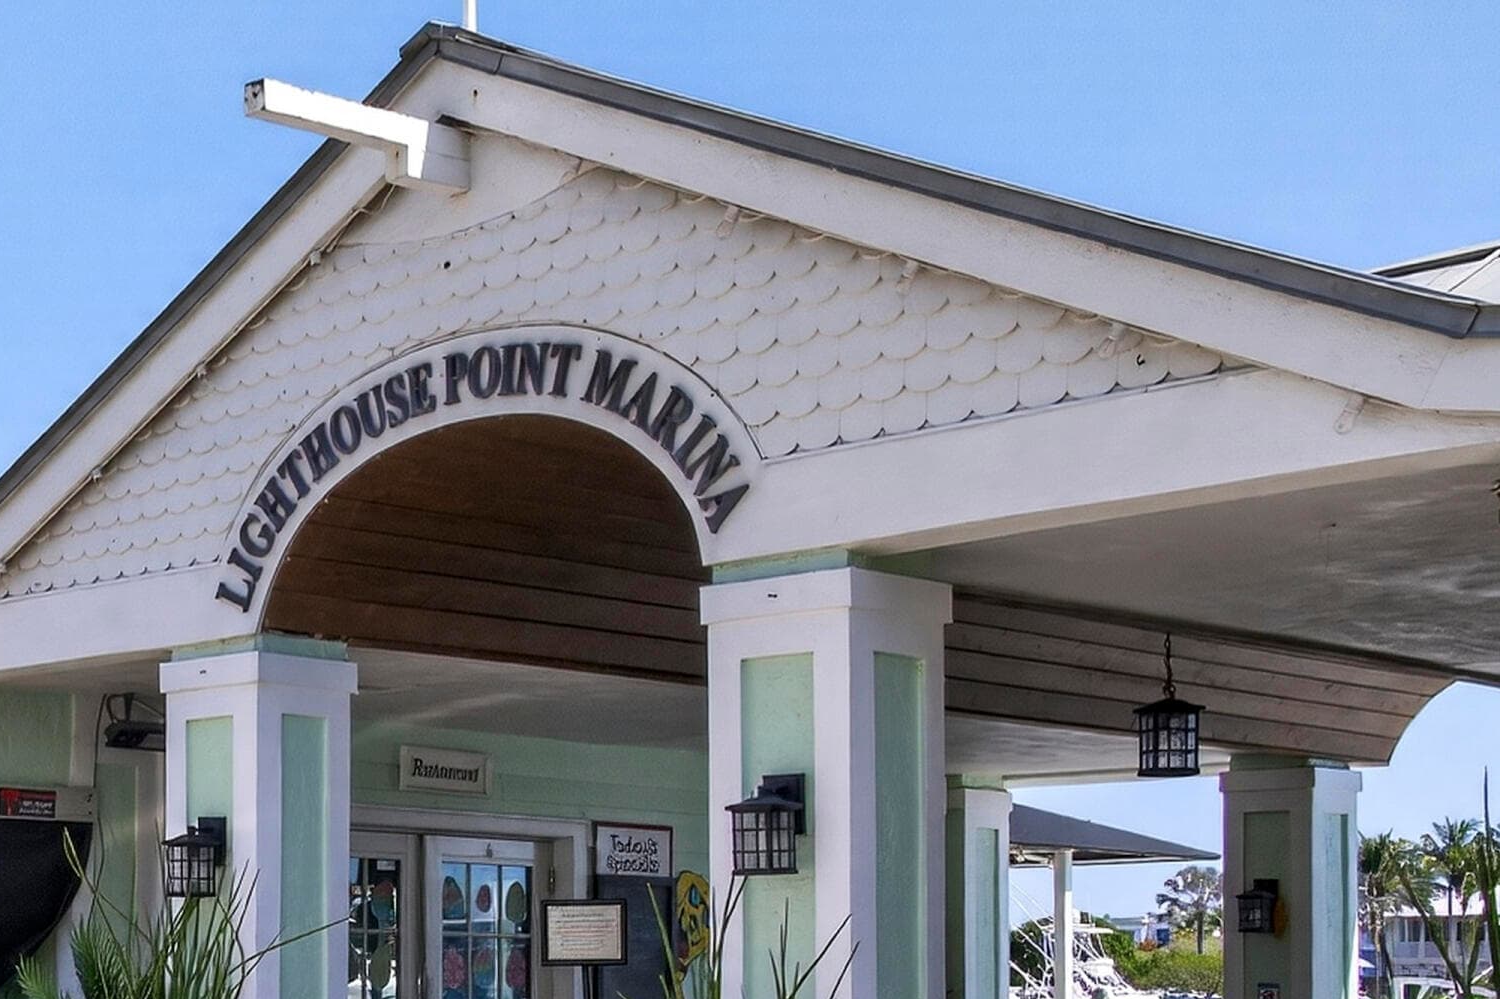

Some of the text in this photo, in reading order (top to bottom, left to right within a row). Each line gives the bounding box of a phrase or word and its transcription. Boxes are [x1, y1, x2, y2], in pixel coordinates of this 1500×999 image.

[215, 343, 750, 613] LIGHTHOUSE POINT MARINA
